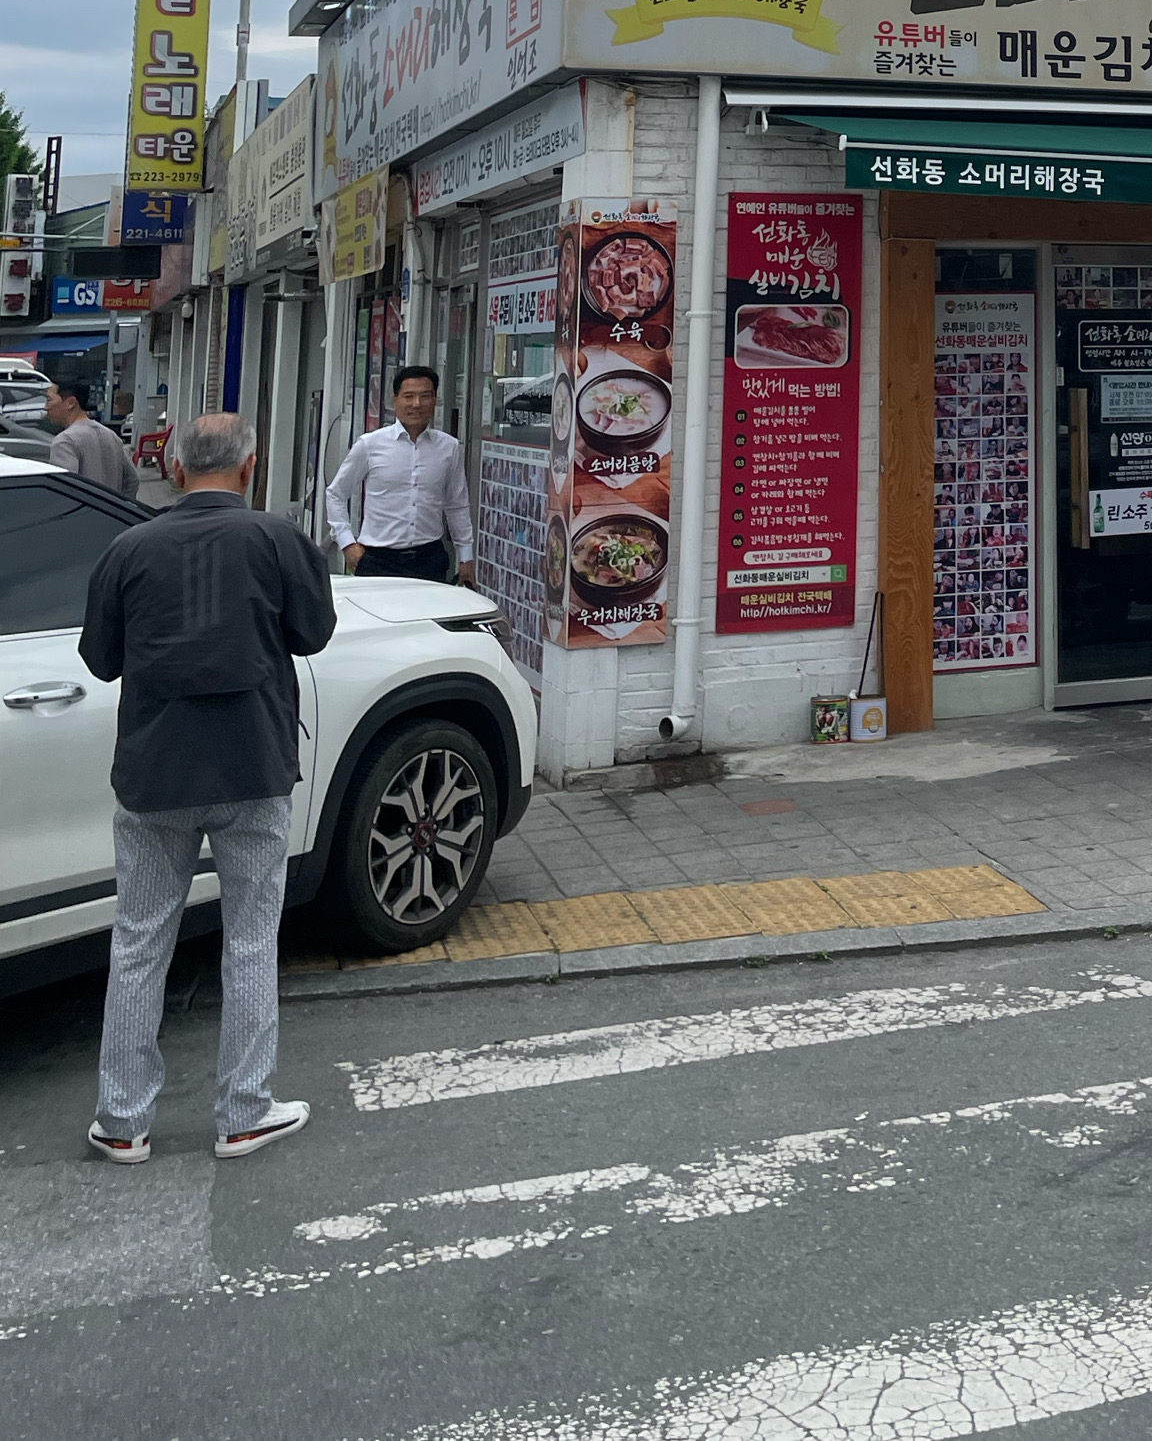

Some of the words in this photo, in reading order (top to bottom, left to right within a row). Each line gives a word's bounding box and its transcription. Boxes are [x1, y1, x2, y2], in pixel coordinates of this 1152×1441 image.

[874, 20, 978, 50] 유튜버들이
[873, 49, 957, 76] 즐겨찾는
[144, 32, 196, 117] 노래
[137, 131, 196, 163] 타운
[143, 172, 200, 183] 223-2979
[870, 155, 946, 186] 선화동
[958, 162, 1105, 196] 소머리해장국
[736, 202, 766, 215] 연예인
[815, 202, 855, 217] 즐겨찾는
[126, 228, 183, 240] 221-4611
[752, 219, 812, 246] 선화동
[765, 245, 805, 270] 매운
[748, 268, 840, 301] 실비김치
[609, 321, 644, 343] 수육
[742, 373, 786, 399] 맛있게
[788, 383, 811, 398] 먹는
[814, 382, 841, 398] 방법!
[588, 454, 659, 474] 소머리곰탕
[1107, 505, 1120, 522] 린
[1122, 503, 1148, 520] 소주
[733, 569, 810, 585] 선화동매운실비김치
[740, 591, 795, 606] 매운실비김치
[797, 589, 833, 603] 전국택배
[577, 604, 660, 626] 우거지해장국
